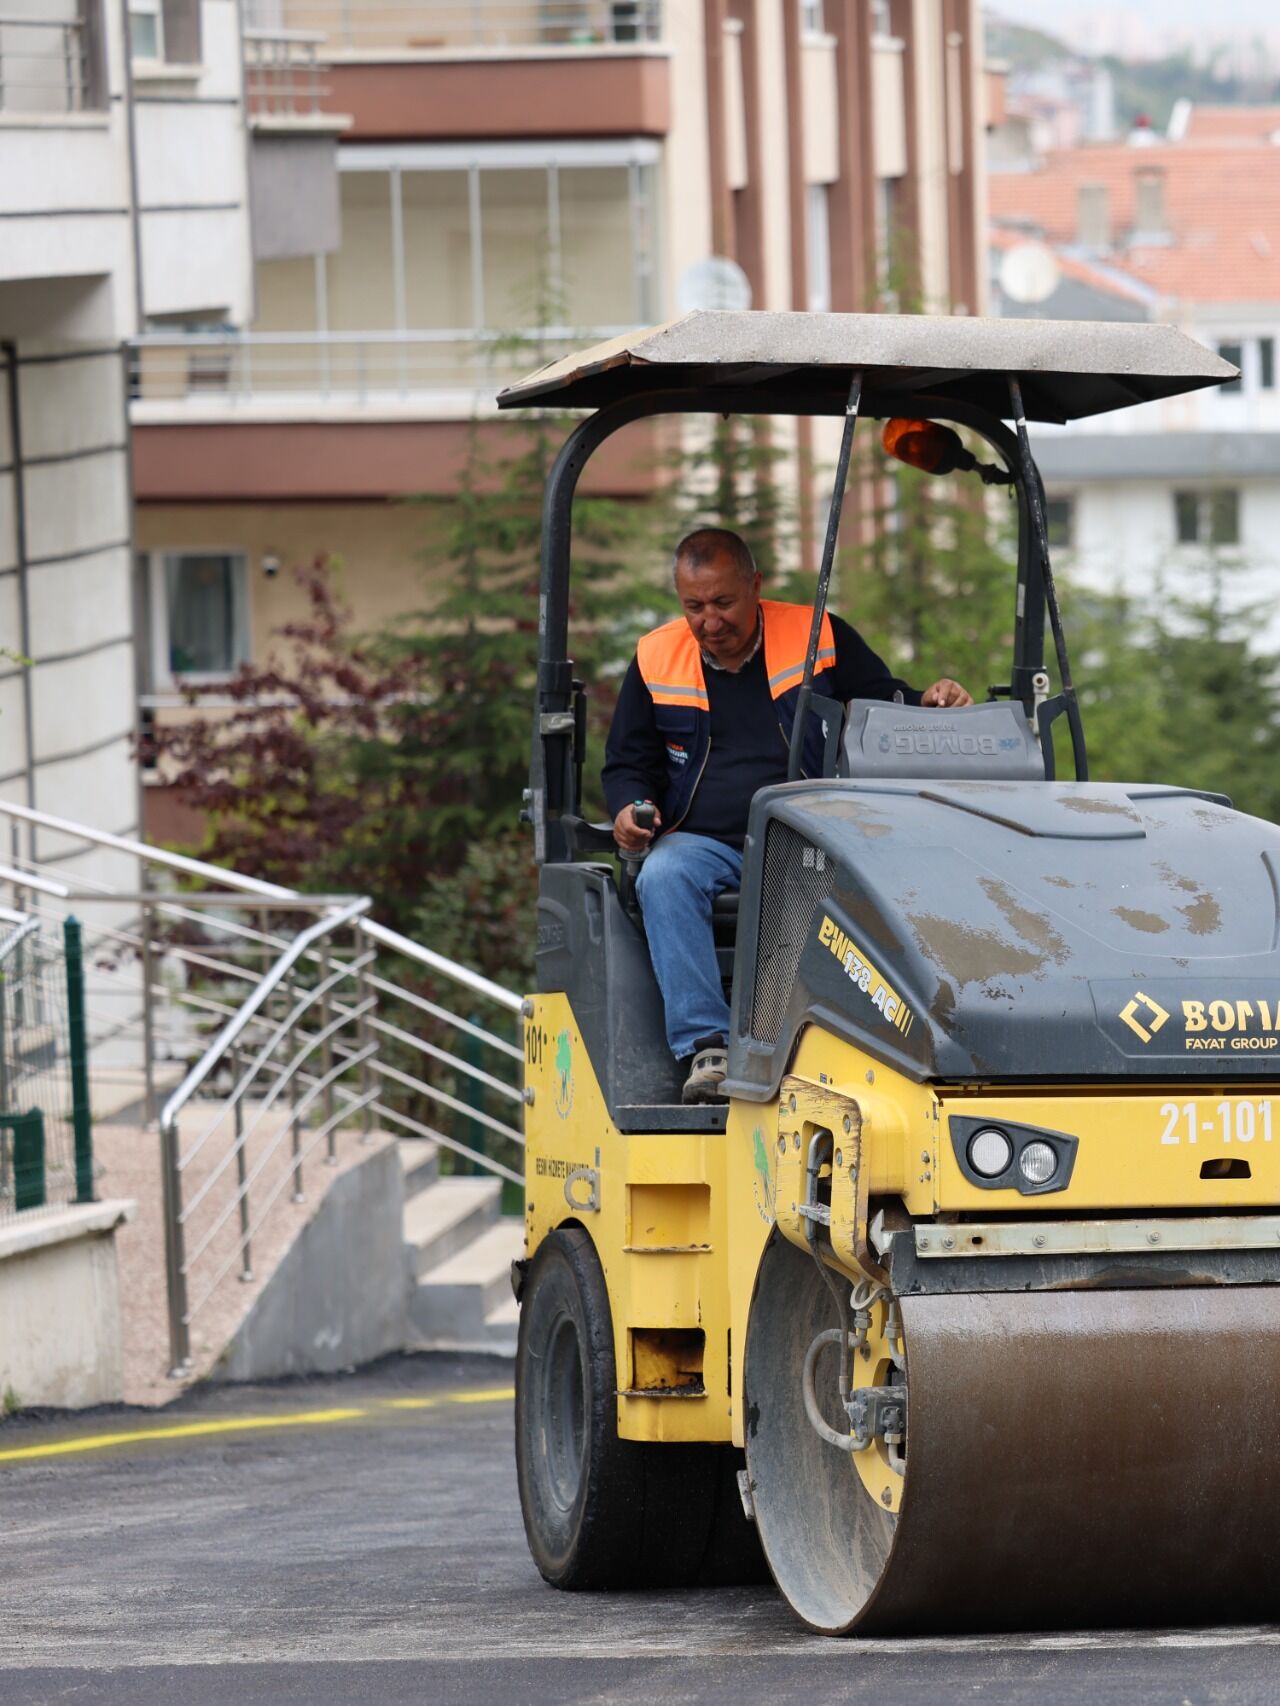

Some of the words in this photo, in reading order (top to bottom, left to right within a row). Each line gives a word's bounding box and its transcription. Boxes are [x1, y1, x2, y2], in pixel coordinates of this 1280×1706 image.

[895, 734, 999, 756] BOMAG
[843, 950, 872, 993] 138
[871, 984, 898, 1023] AC
[1185, 1038, 1227, 1050] FAYAT
[1230, 1037, 1279, 1050] GROUP
[1160, 1100, 1273, 1145] 21-101
